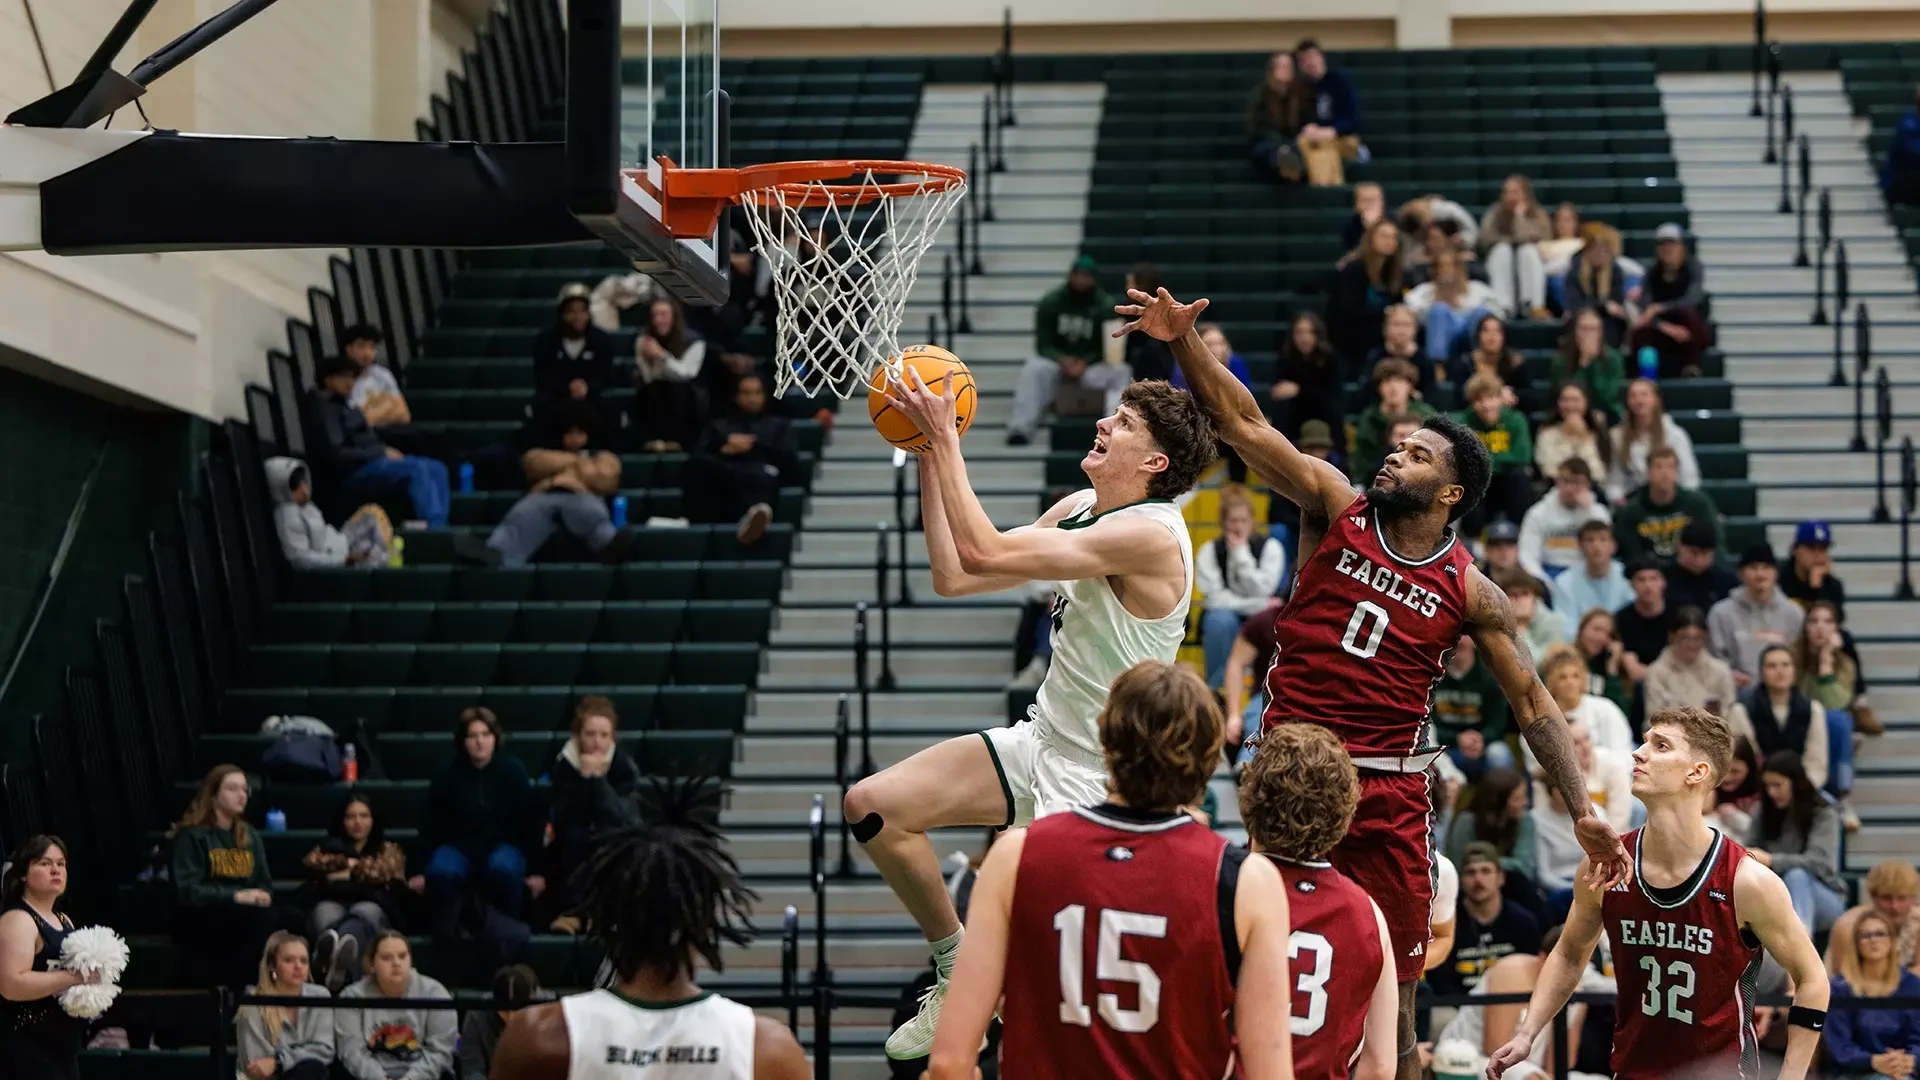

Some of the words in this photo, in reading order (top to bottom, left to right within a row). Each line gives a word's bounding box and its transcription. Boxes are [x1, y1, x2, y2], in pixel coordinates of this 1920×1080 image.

[1335, 548, 1442, 618] EAGLES
[1341, 600, 1390, 659] 0
[1053, 904, 1168, 1033] 15
[1620, 919, 1714, 955] EAGLES
[1287, 930, 1334, 1037] 3
[1639, 955, 1696, 1025] 32
[665, 1046, 719, 1063] HILLS
